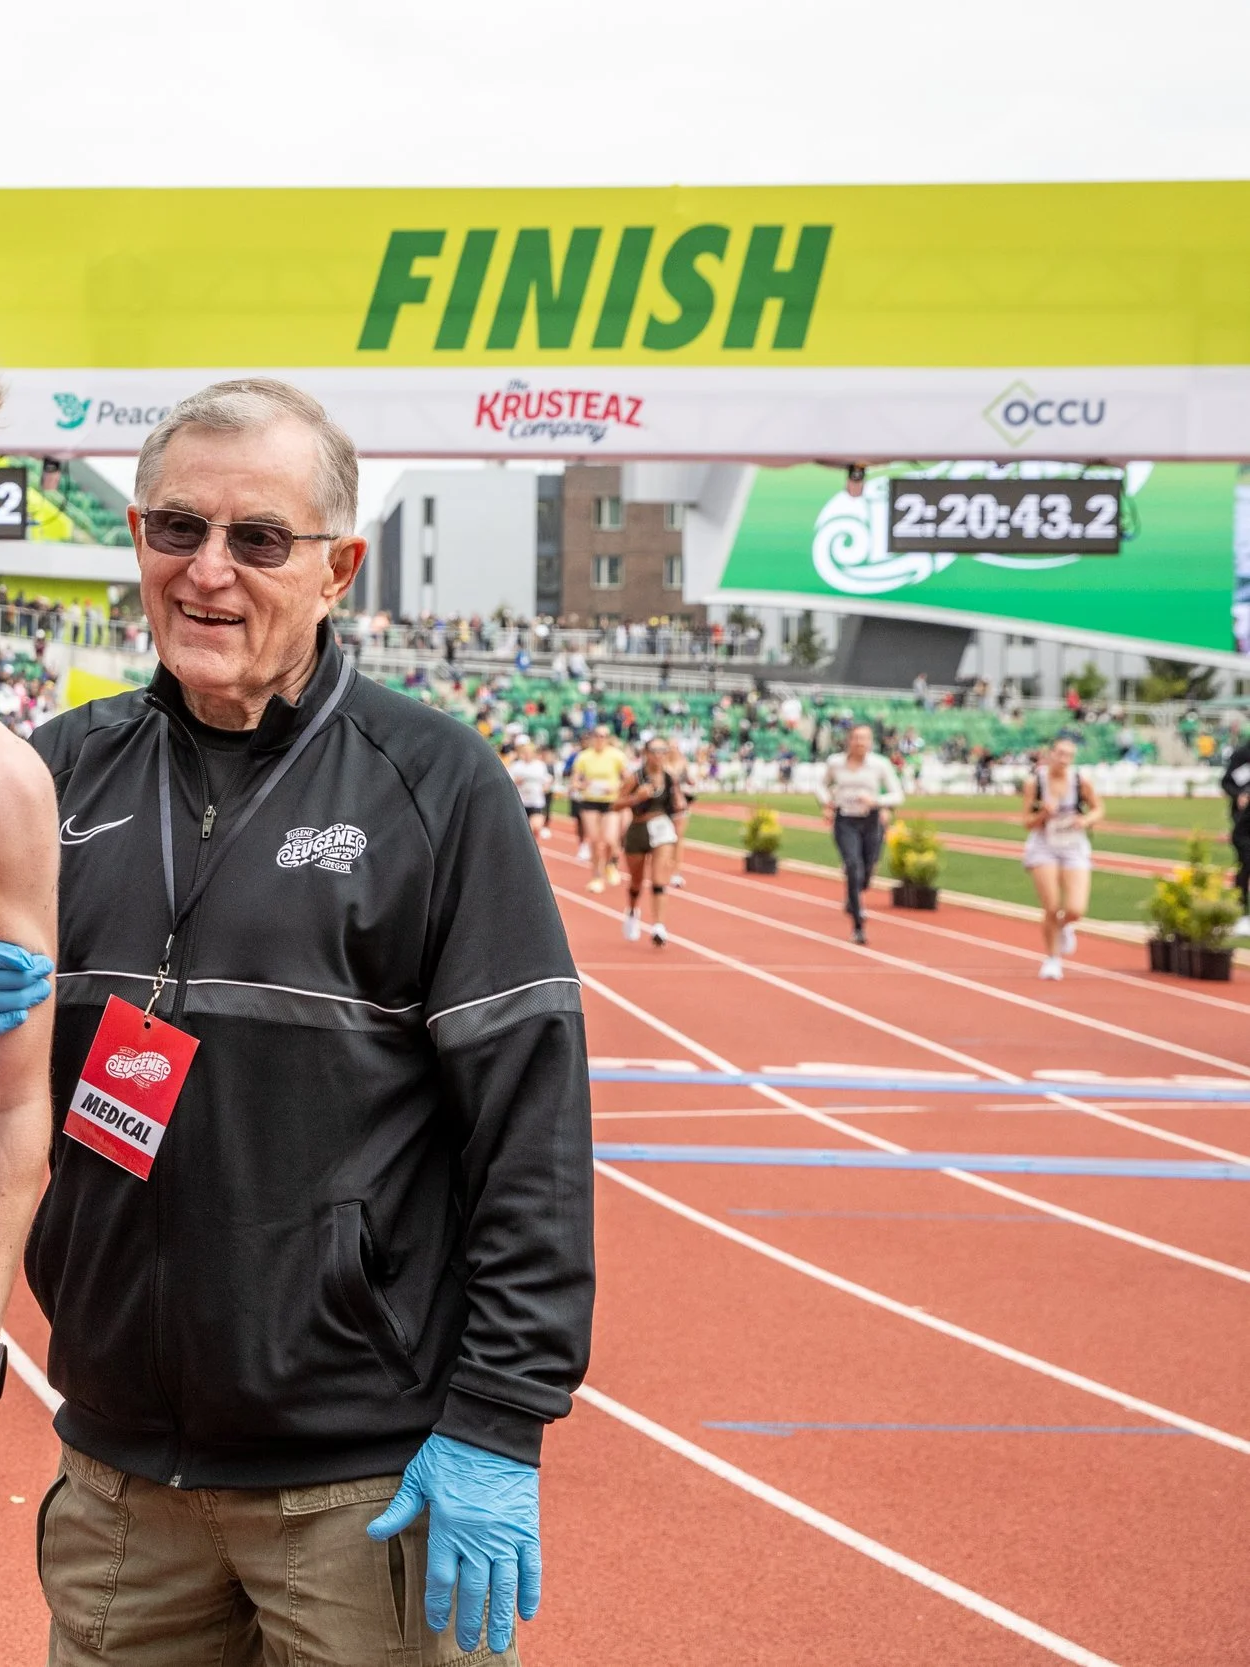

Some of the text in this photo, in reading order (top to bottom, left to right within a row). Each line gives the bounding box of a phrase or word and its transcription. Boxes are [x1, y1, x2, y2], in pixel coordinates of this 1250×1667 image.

[356, 223, 835, 352] FINISH
[475, 390, 645, 432] KRUSTEAZ
[1003, 399, 1107, 426] OCCU
[508, 418, 608, 443] Company
[892, 493, 1118, 539] 2:20:43.2
[287, 829, 314, 840] EUGENE
[291, 831, 359, 860] EUGENE
[311, 845, 356, 862] MARATHON
[319, 858, 351, 872] OREGON
[115, 1057, 164, 1073] EUGENE
[80, 1092, 152, 1146] MEDICAL
